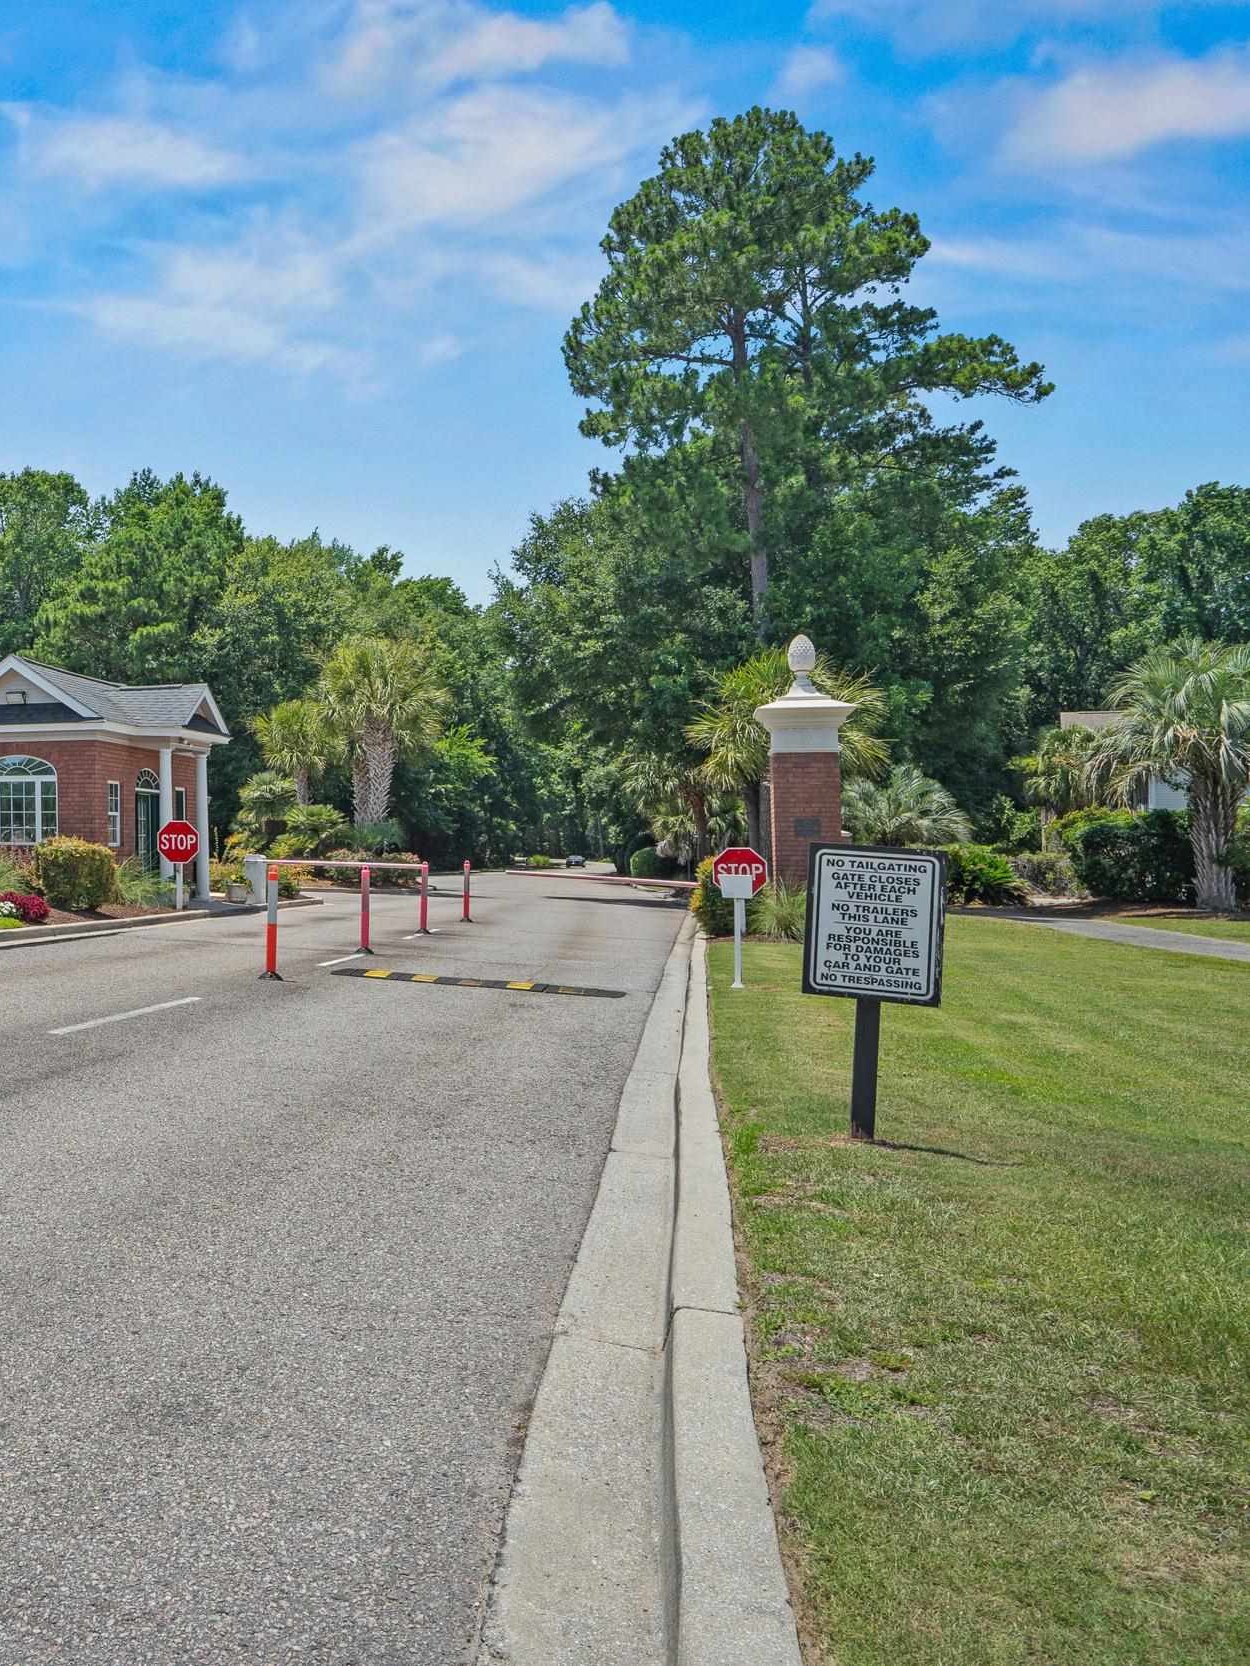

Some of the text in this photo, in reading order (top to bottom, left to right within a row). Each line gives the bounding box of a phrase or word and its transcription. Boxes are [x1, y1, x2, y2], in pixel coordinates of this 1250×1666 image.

[161, 834, 196, 850] STOP
[718, 864, 763, 880] STOP
[826, 859, 927, 873] NO TAILGATING
[832, 872, 920, 886] GATE CLOSES
[835, 882, 916, 895] AFTER EACH
[848, 891, 902, 903] VEHICLE
[831, 903, 918, 917] NO TRAILERS
[840, 913, 908, 926] THIS LANE
[845, 926, 902, 938] YOU ARE
[828, 934, 918, 949] RESPONSIBLE
[826, 943, 919, 958] FOR DAMAGES
[843, 953, 901, 965] TO YOUR
[824, 960, 920, 976] CAR AND GATE
[820, 973, 922, 990] NO TRESPASSING
